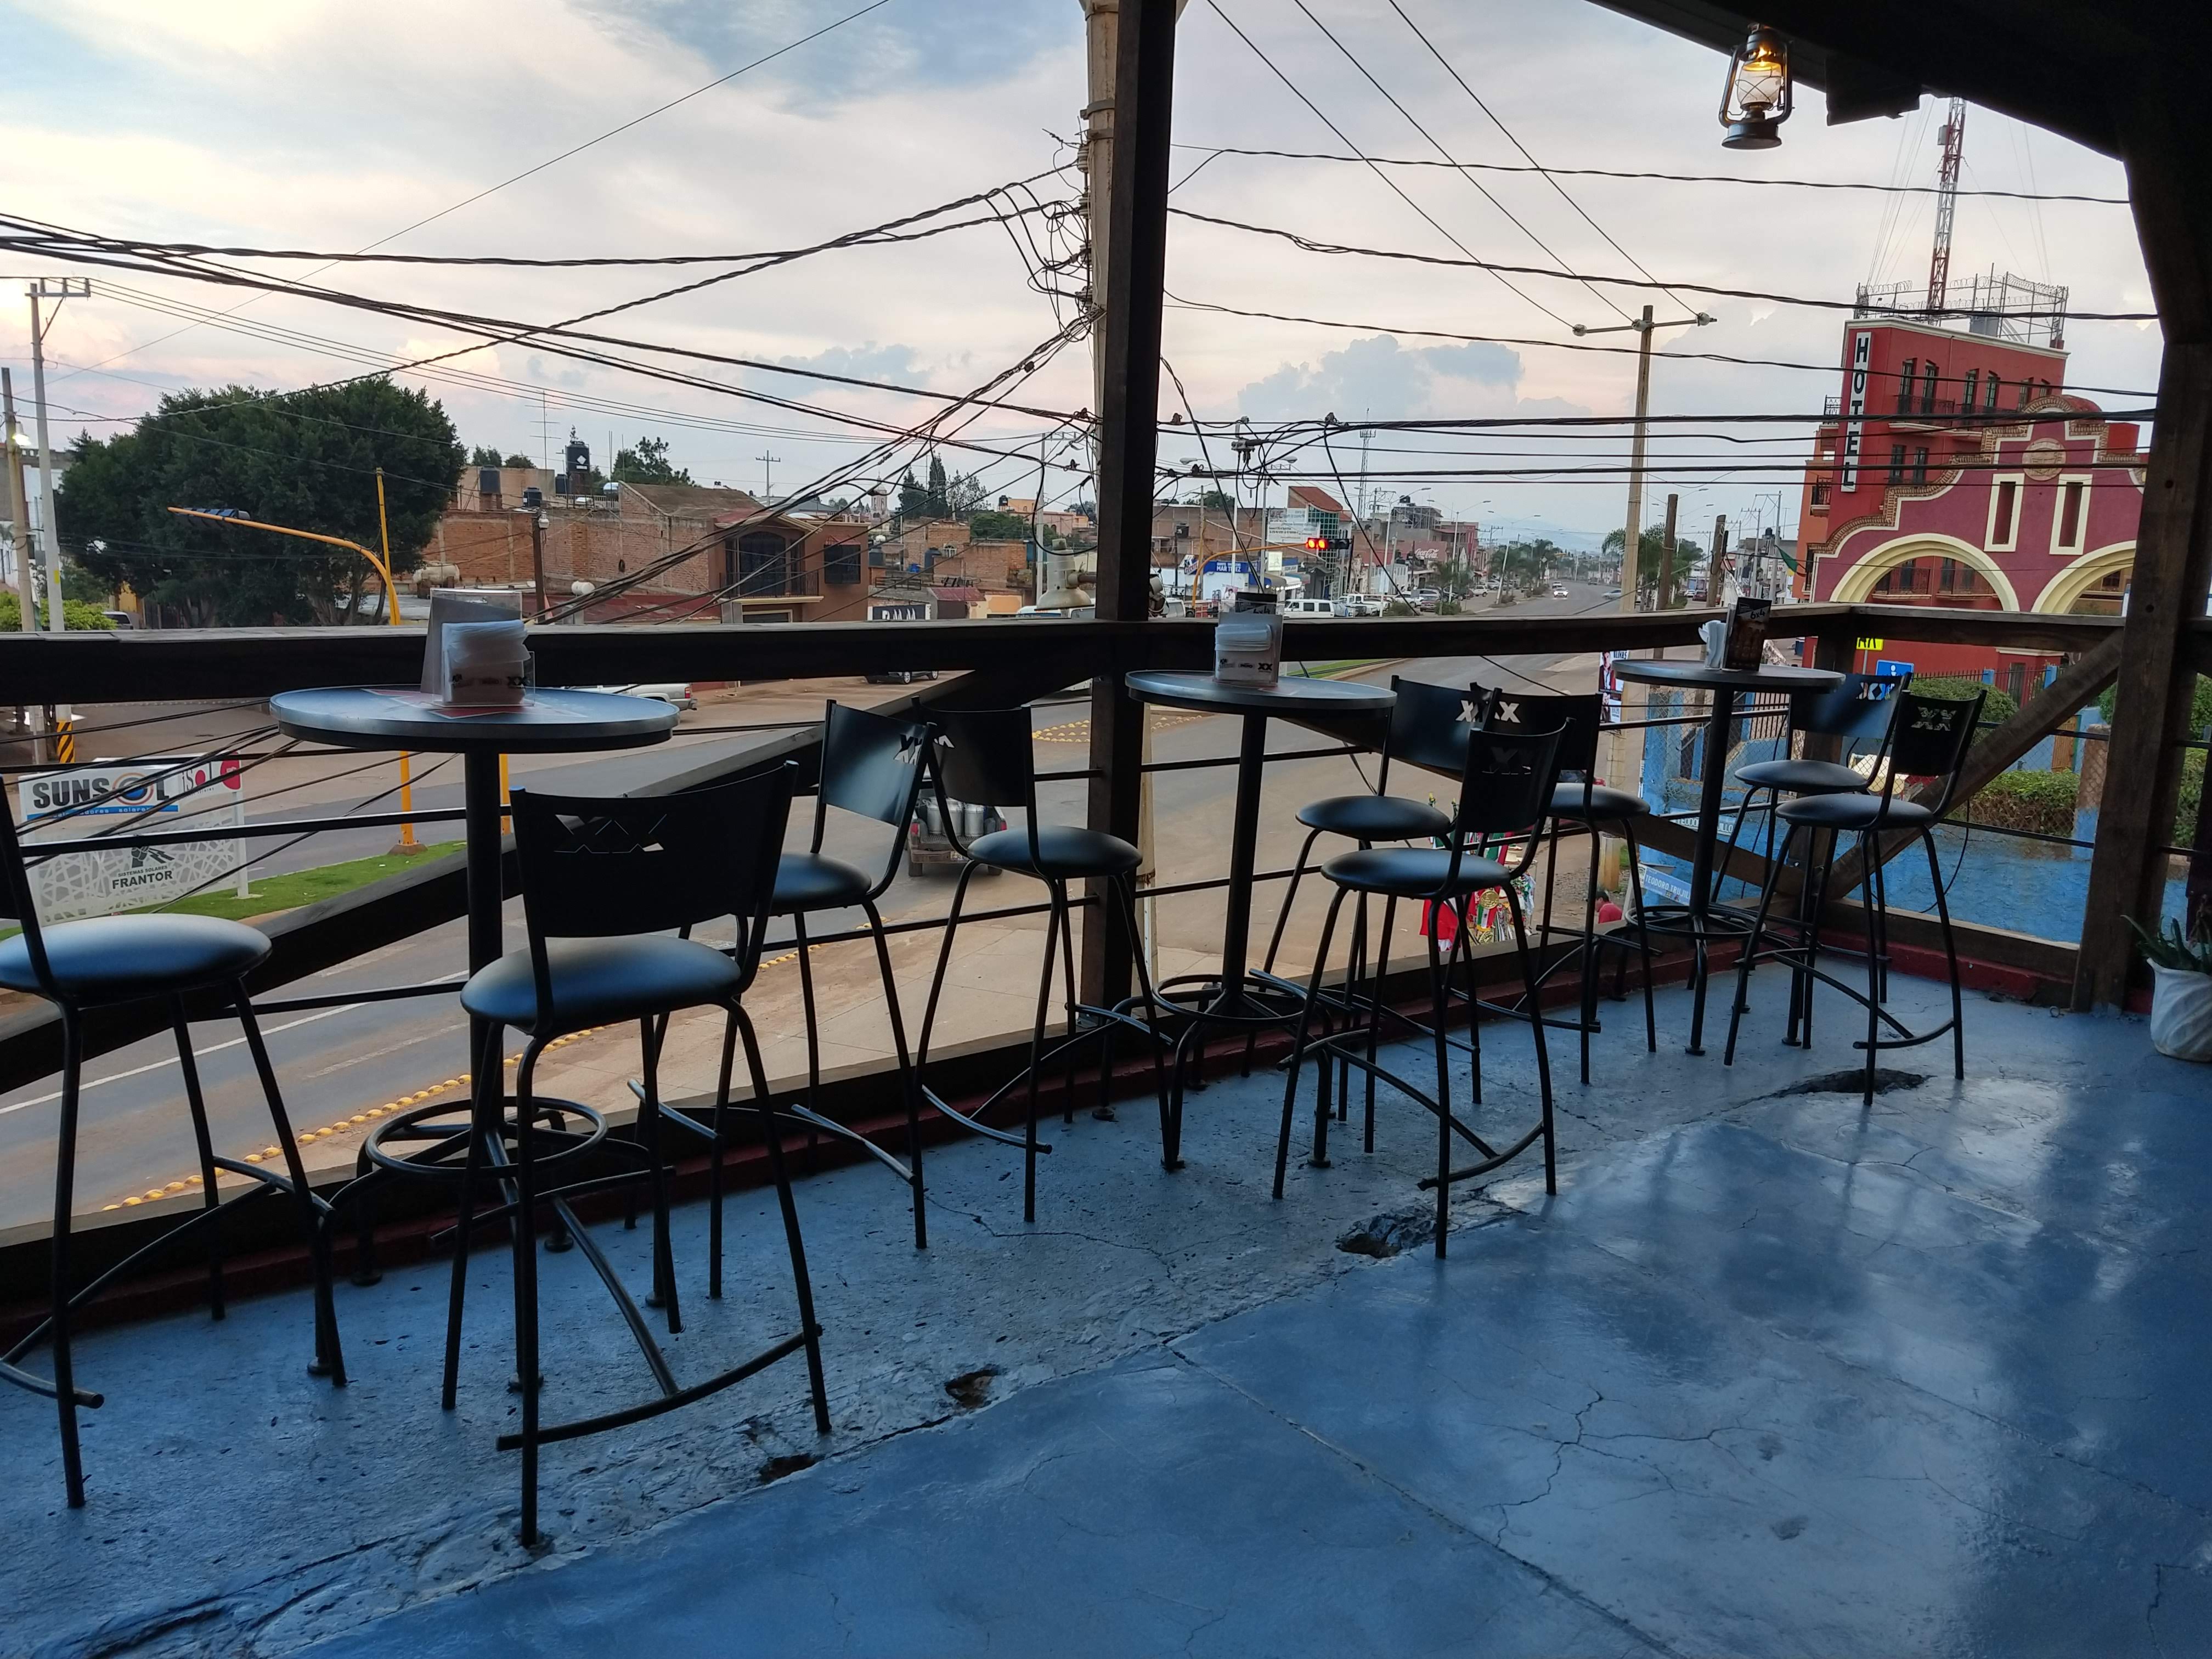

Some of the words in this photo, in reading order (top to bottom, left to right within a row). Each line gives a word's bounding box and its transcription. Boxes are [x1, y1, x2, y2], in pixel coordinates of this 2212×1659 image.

[1843, 338, 1869, 487] HOTEL
[1750, 609, 1765, 619] 6x4
[1718, 822, 1734, 833] JILLO
[112, 870, 173, 889] FRANTOR
[1645, 874, 1669, 890] TEODORO
[1670, 884, 1690, 899] TRUJIL
